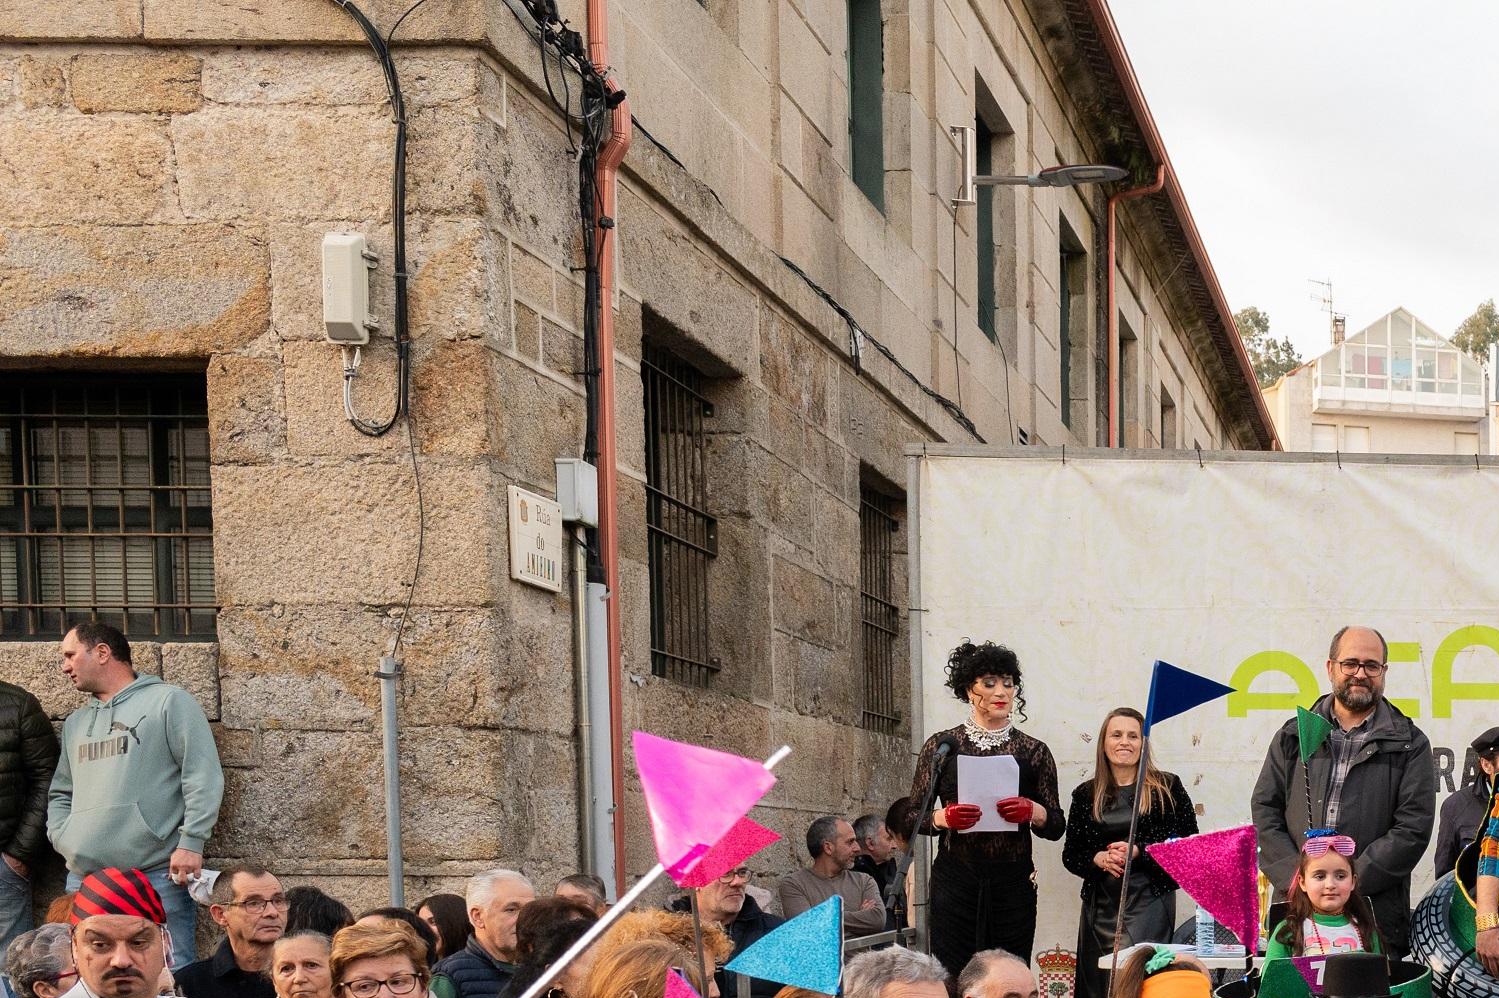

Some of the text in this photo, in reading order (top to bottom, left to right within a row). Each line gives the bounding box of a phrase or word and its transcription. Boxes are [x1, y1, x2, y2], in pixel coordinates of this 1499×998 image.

[536, 504, 551, 526] Rúa
[536, 533, 545, 551] do
[79, 736, 128, 763] PUMA
[1310, 960, 1326, 985] 7
